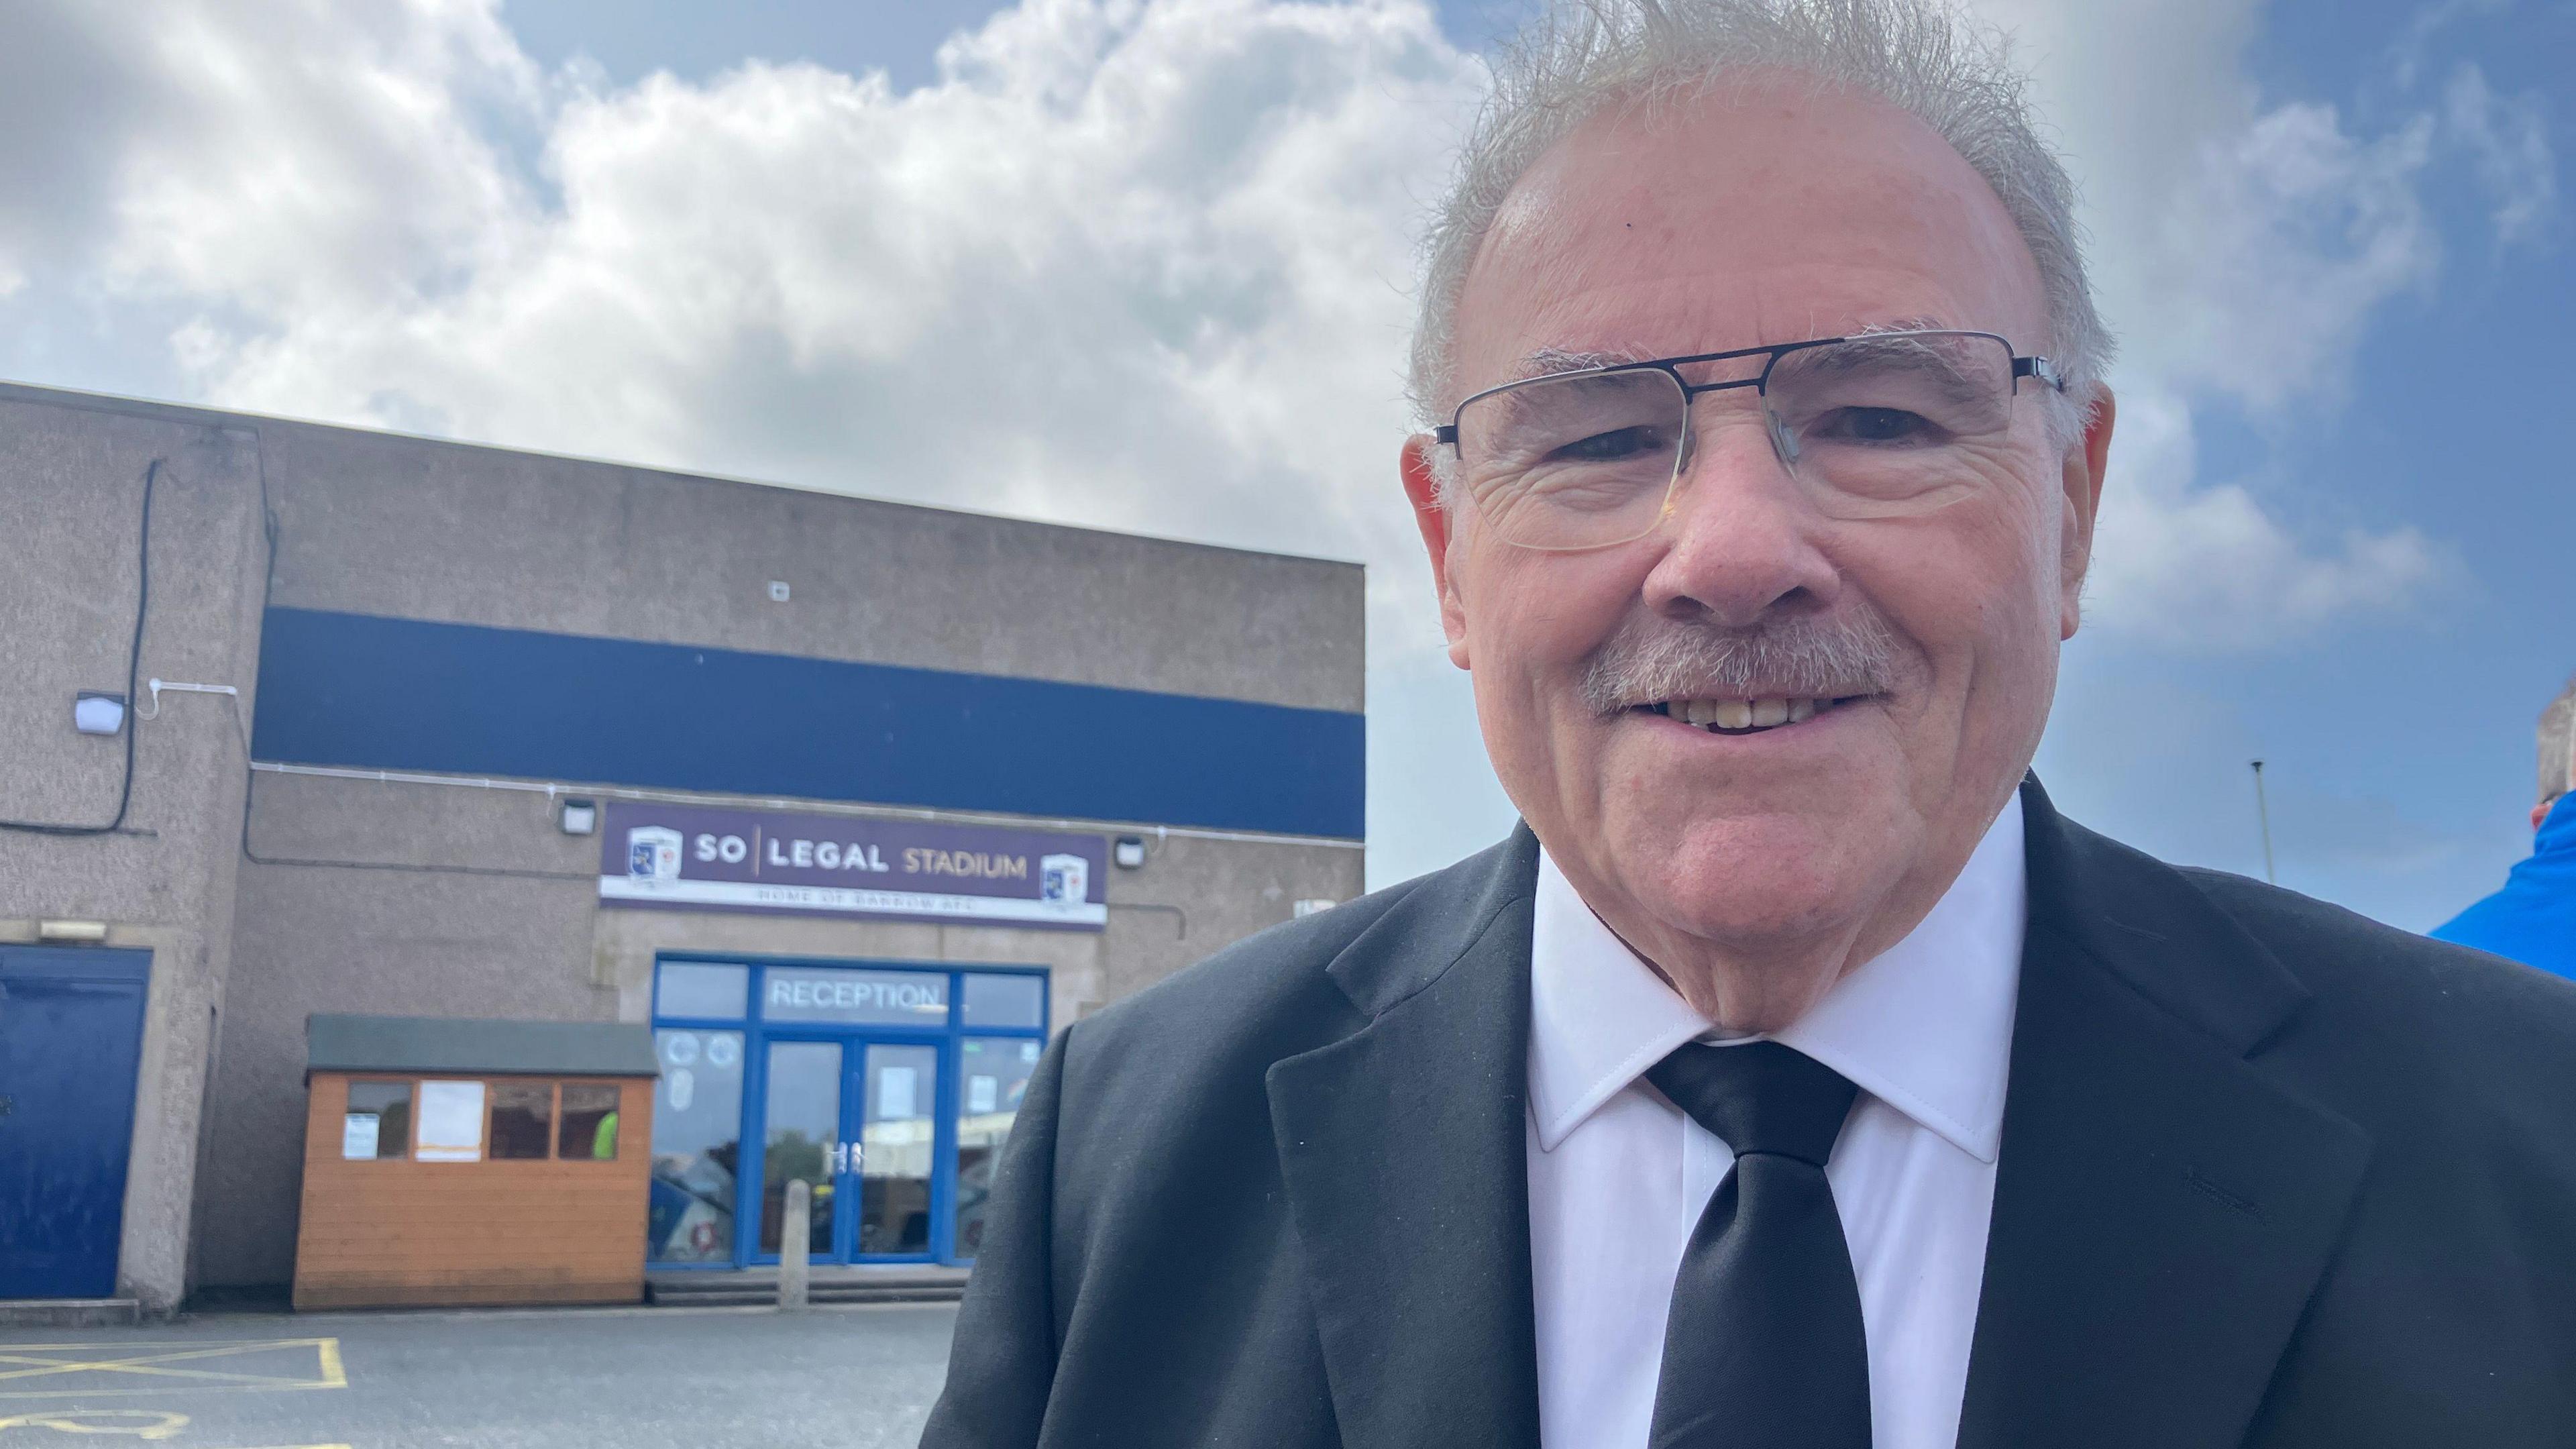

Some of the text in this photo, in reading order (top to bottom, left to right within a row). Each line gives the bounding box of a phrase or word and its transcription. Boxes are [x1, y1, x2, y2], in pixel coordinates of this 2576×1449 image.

[693, 834, 1027, 879] SO LEGAL STADIUM
[757, 888, 811, 904] HOME
[822, 890, 843, 904] OF
[773, 979, 938, 1008] RECEPTION
